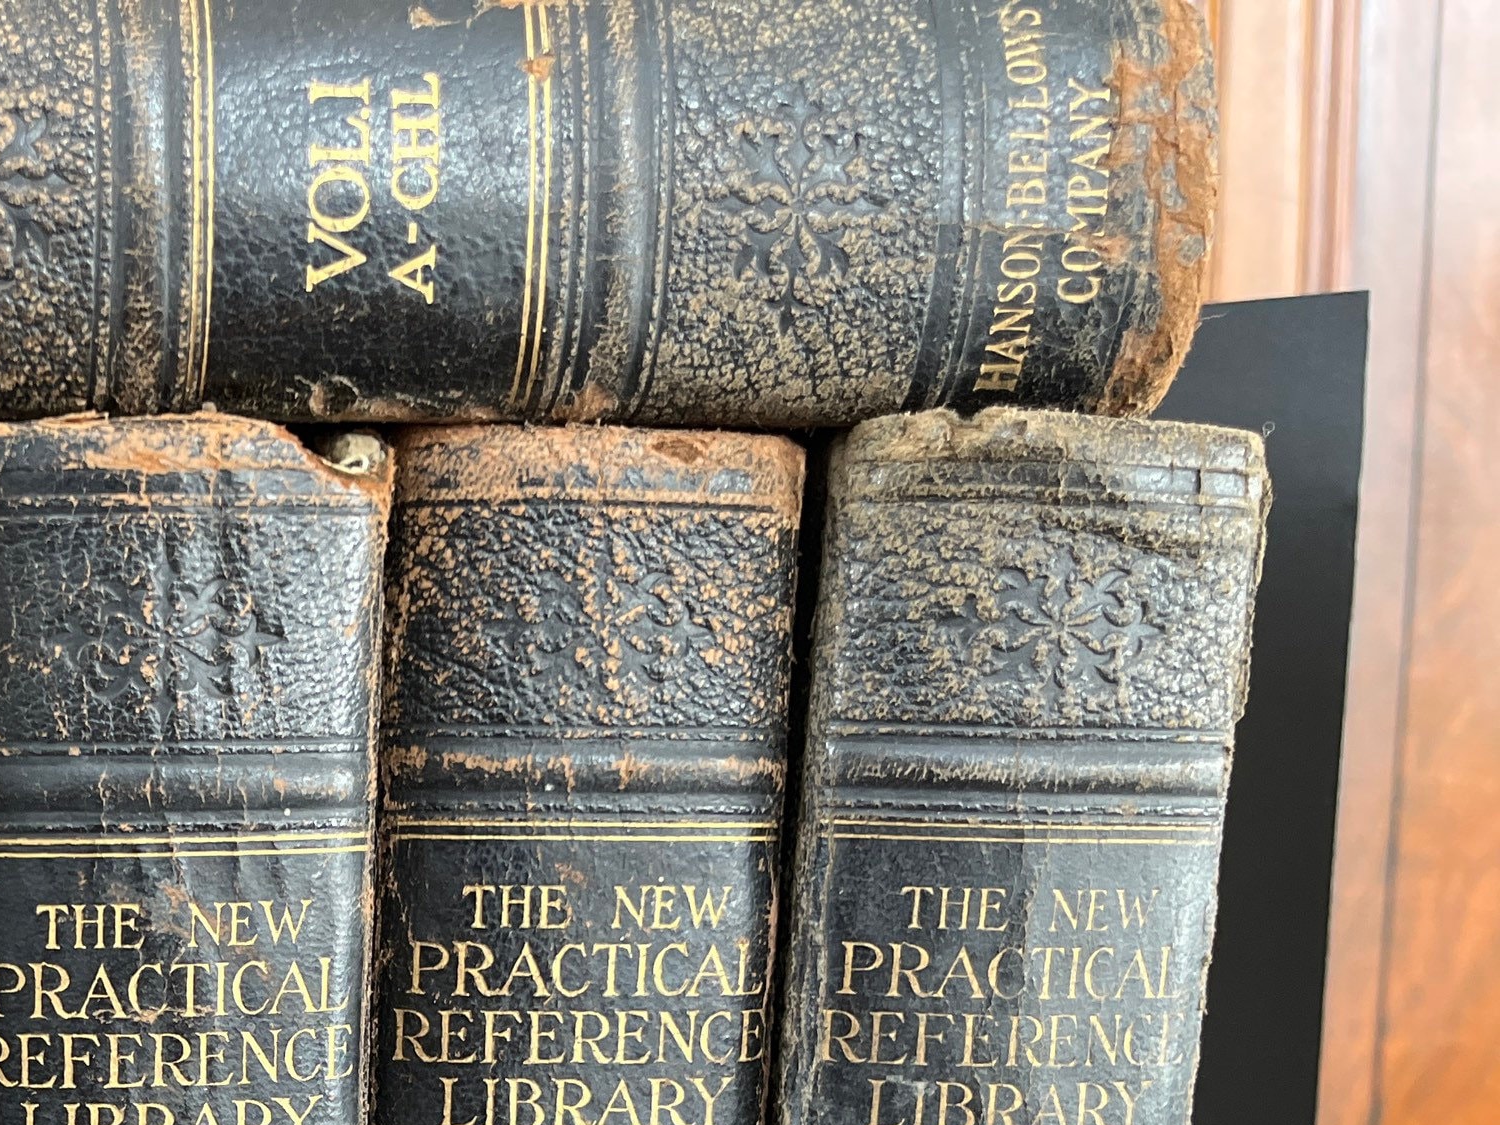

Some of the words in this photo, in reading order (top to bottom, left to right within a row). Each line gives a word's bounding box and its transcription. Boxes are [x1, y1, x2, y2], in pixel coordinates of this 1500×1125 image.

[389, 72, 441, 304] A-CHL
[1057, 78, 1110, 304] COMPANY
[36, 904, 145, 950] THE
[188, 900, 313, 948] NEW
[462, 885, 571, 929] THE
[610, 885, 733, 929] NEW
[901, 887, 1010, 931] THE
[1049, 889, 1160, 932] NEW
[406, 940, 763, 997] PRACTICAL
[836, 941, 1180, 1000] PRACTICAL
[392, 1007, 763, 1065] REFERENCE
[821, 1010, 1183, 1067] REFERENCE
